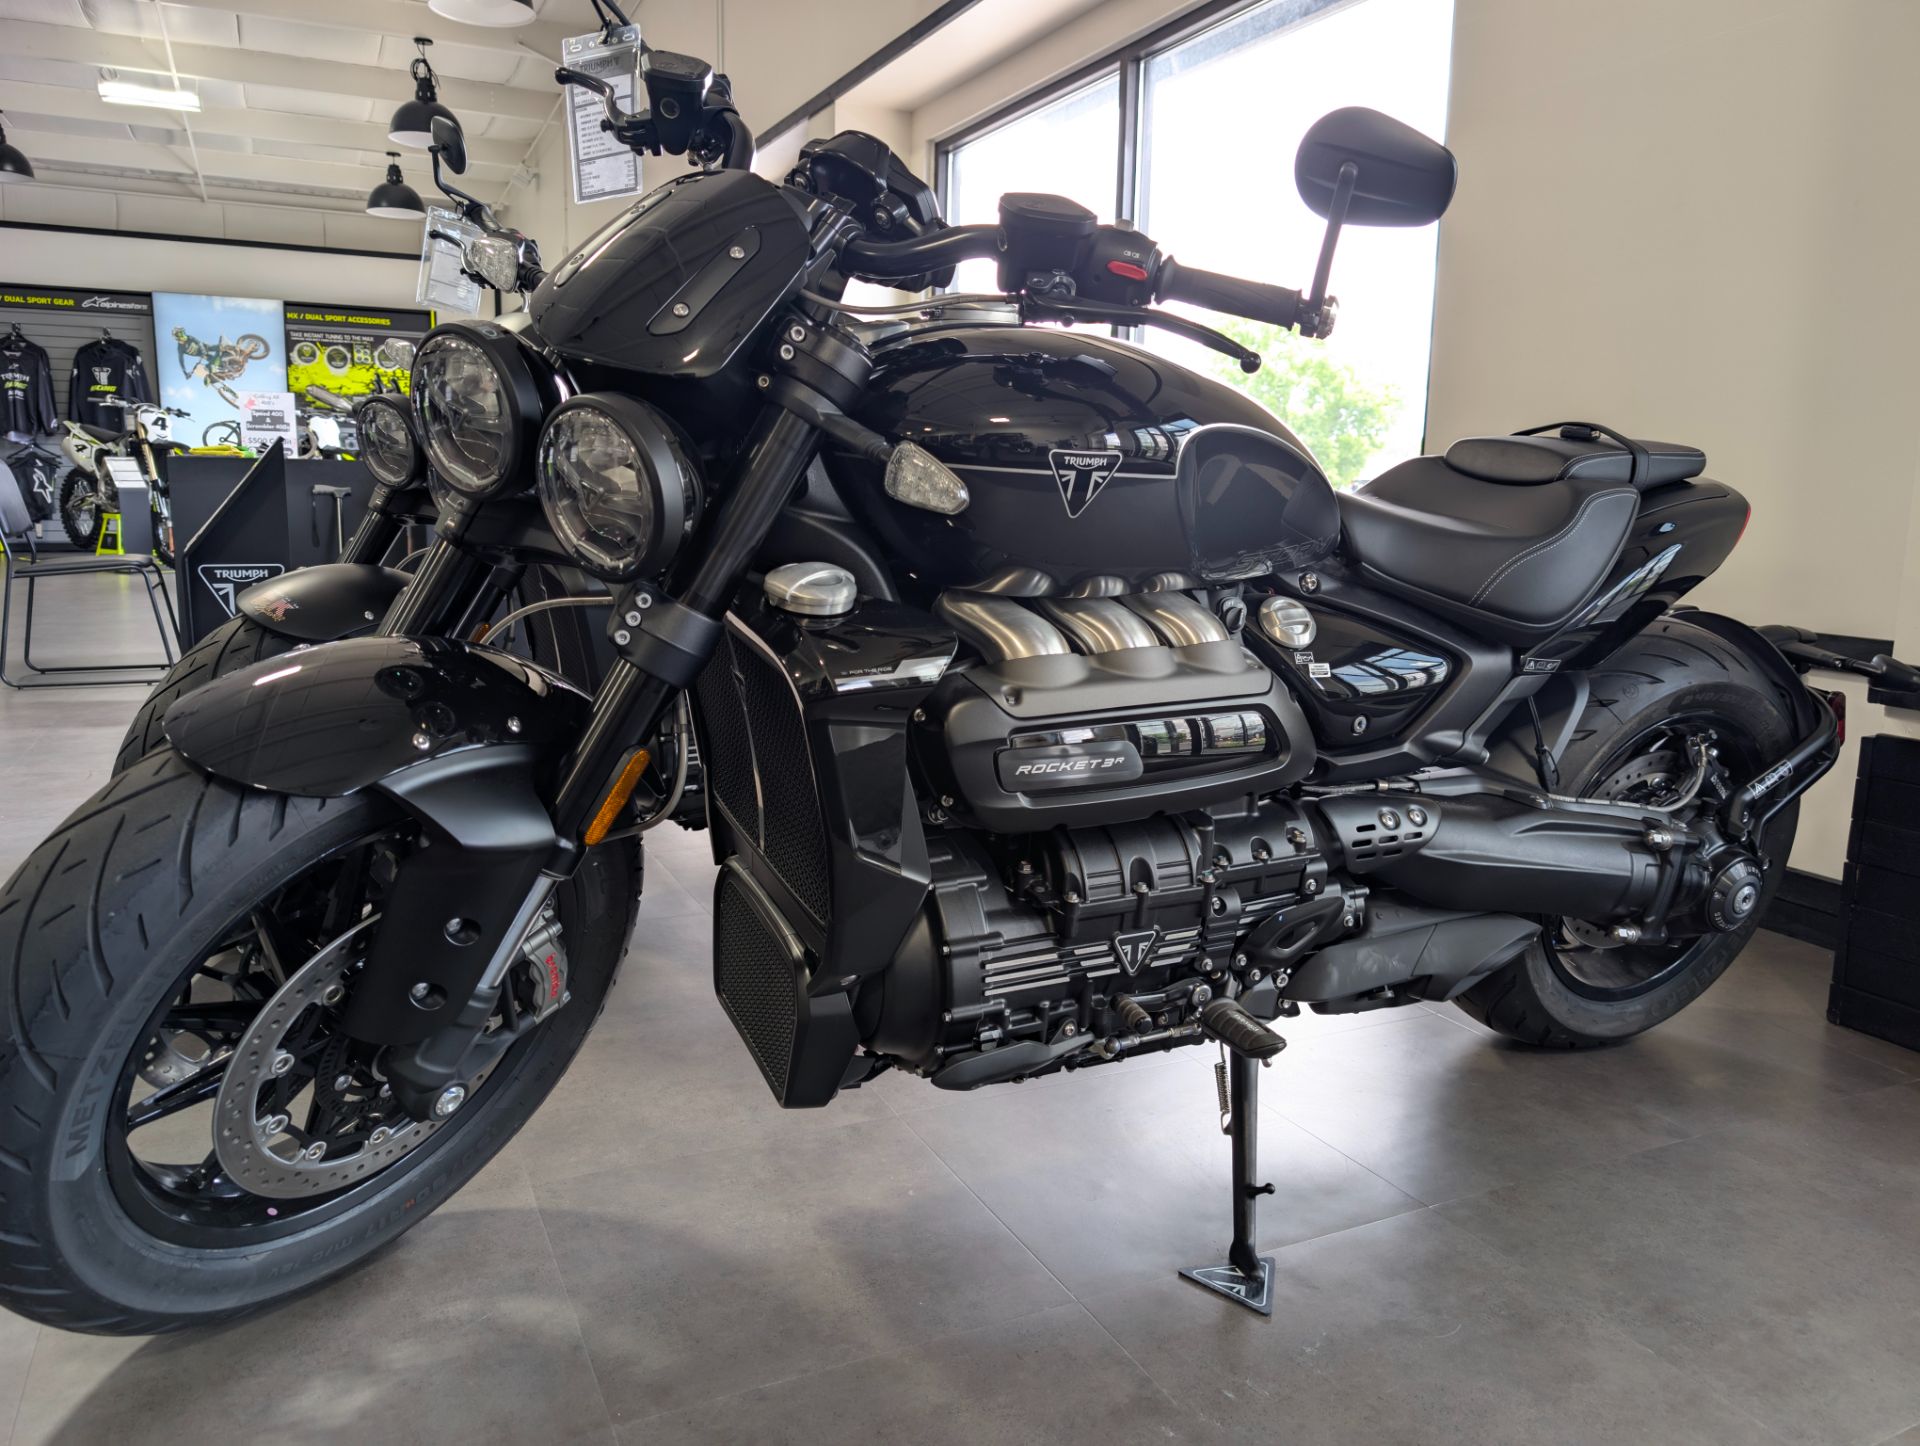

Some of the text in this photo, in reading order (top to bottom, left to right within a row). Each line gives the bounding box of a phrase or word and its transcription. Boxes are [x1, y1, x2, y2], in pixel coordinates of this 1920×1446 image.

[26, 297, 51, 305] SPORT
[53, 298, 75, 306] GEAR
[100, 302, 149, 310] alpinestars
[305, 313, 324, 321] DUAL
[325, 314, 346, 323] SPORT
[348, 316, 391, 326] ACCESSORIES
[151, 416, 168, 431] 4
[75, 444, 88, 453] 4
[1064, 456, 1107, 466] TRIUMPH
[213, 568, 269, 579] TRIUMPH
